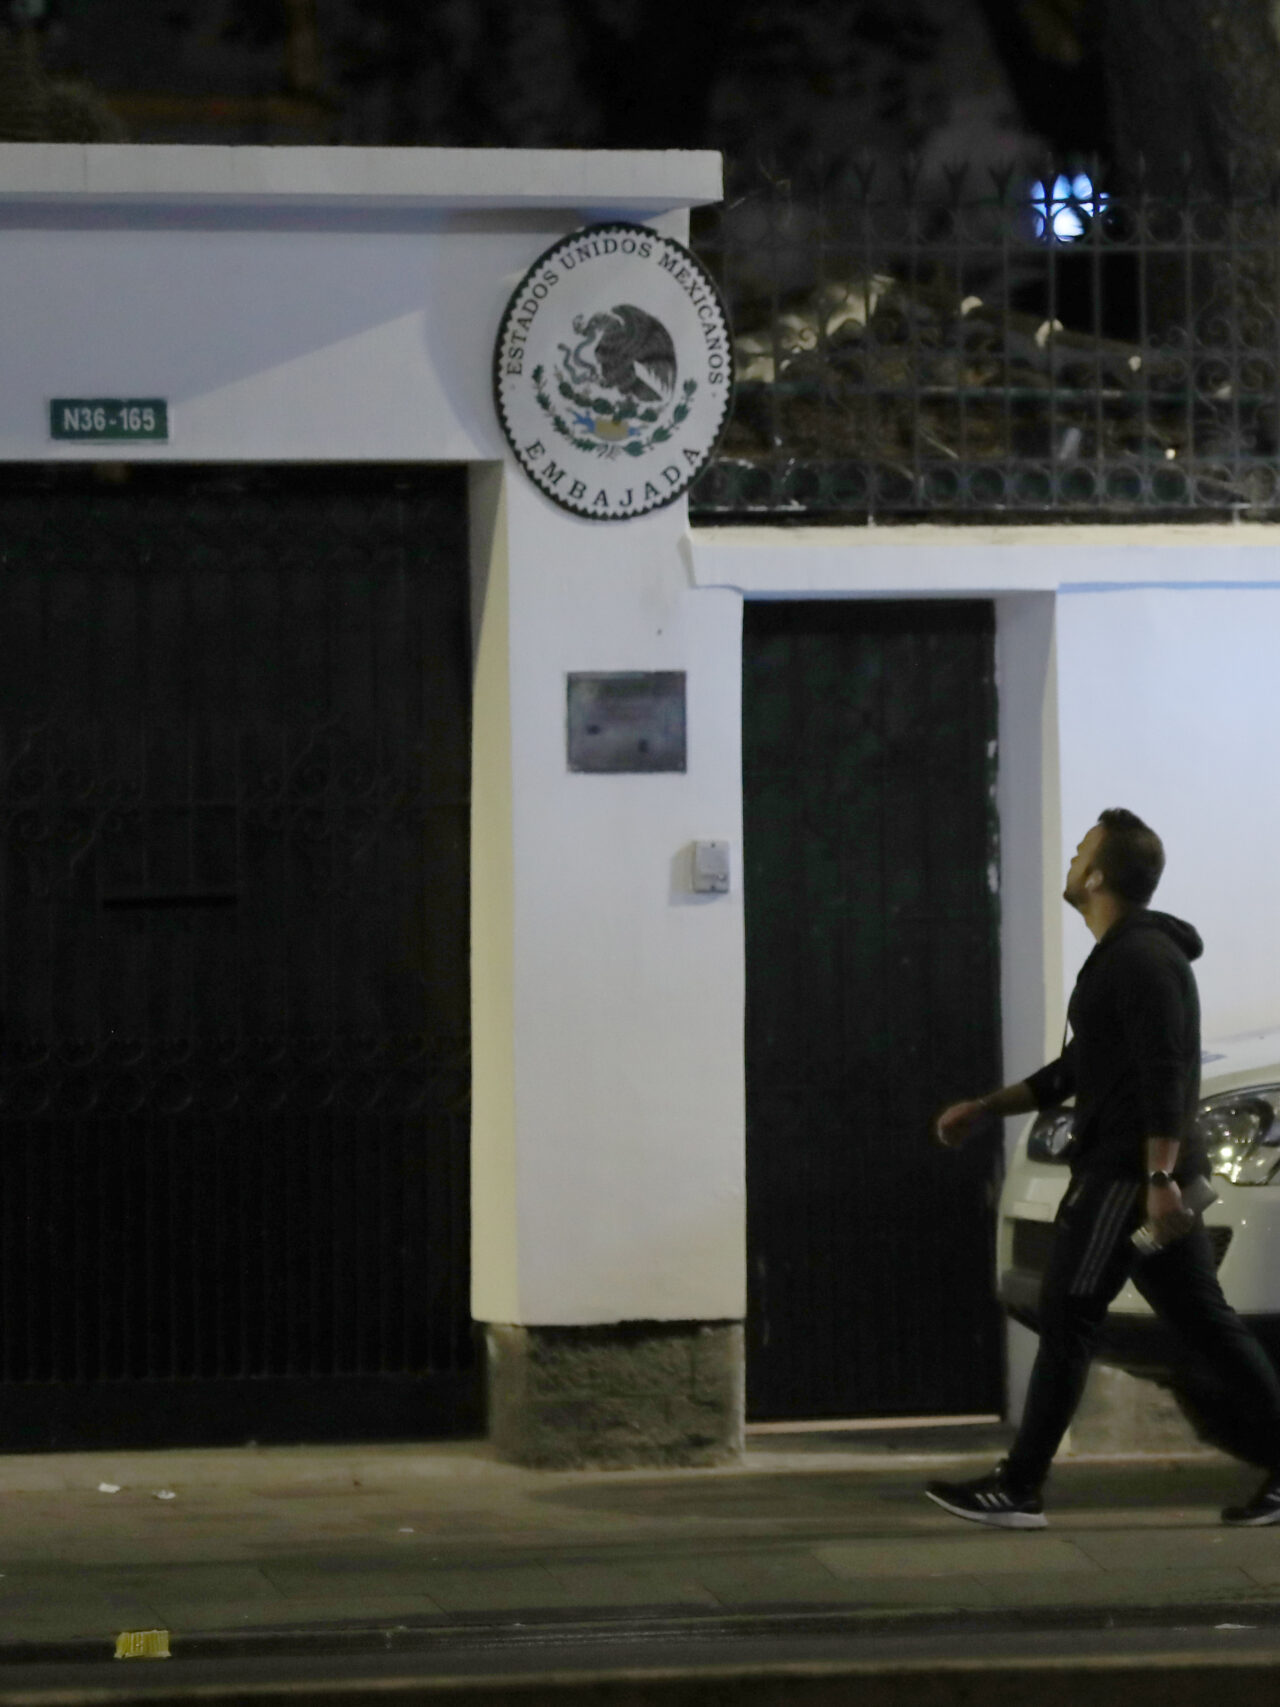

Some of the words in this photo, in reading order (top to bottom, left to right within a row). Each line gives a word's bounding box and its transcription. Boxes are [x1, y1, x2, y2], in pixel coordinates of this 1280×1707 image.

[507, 271, 558, 376] ESTADOS
[560, 237, 652, 270] UNIDOS
[657, 253, 723, 385] MEXICANOS
[63, 407, 155, 431] N36-165
[526, 440, 699, 507] EMBAJADA
